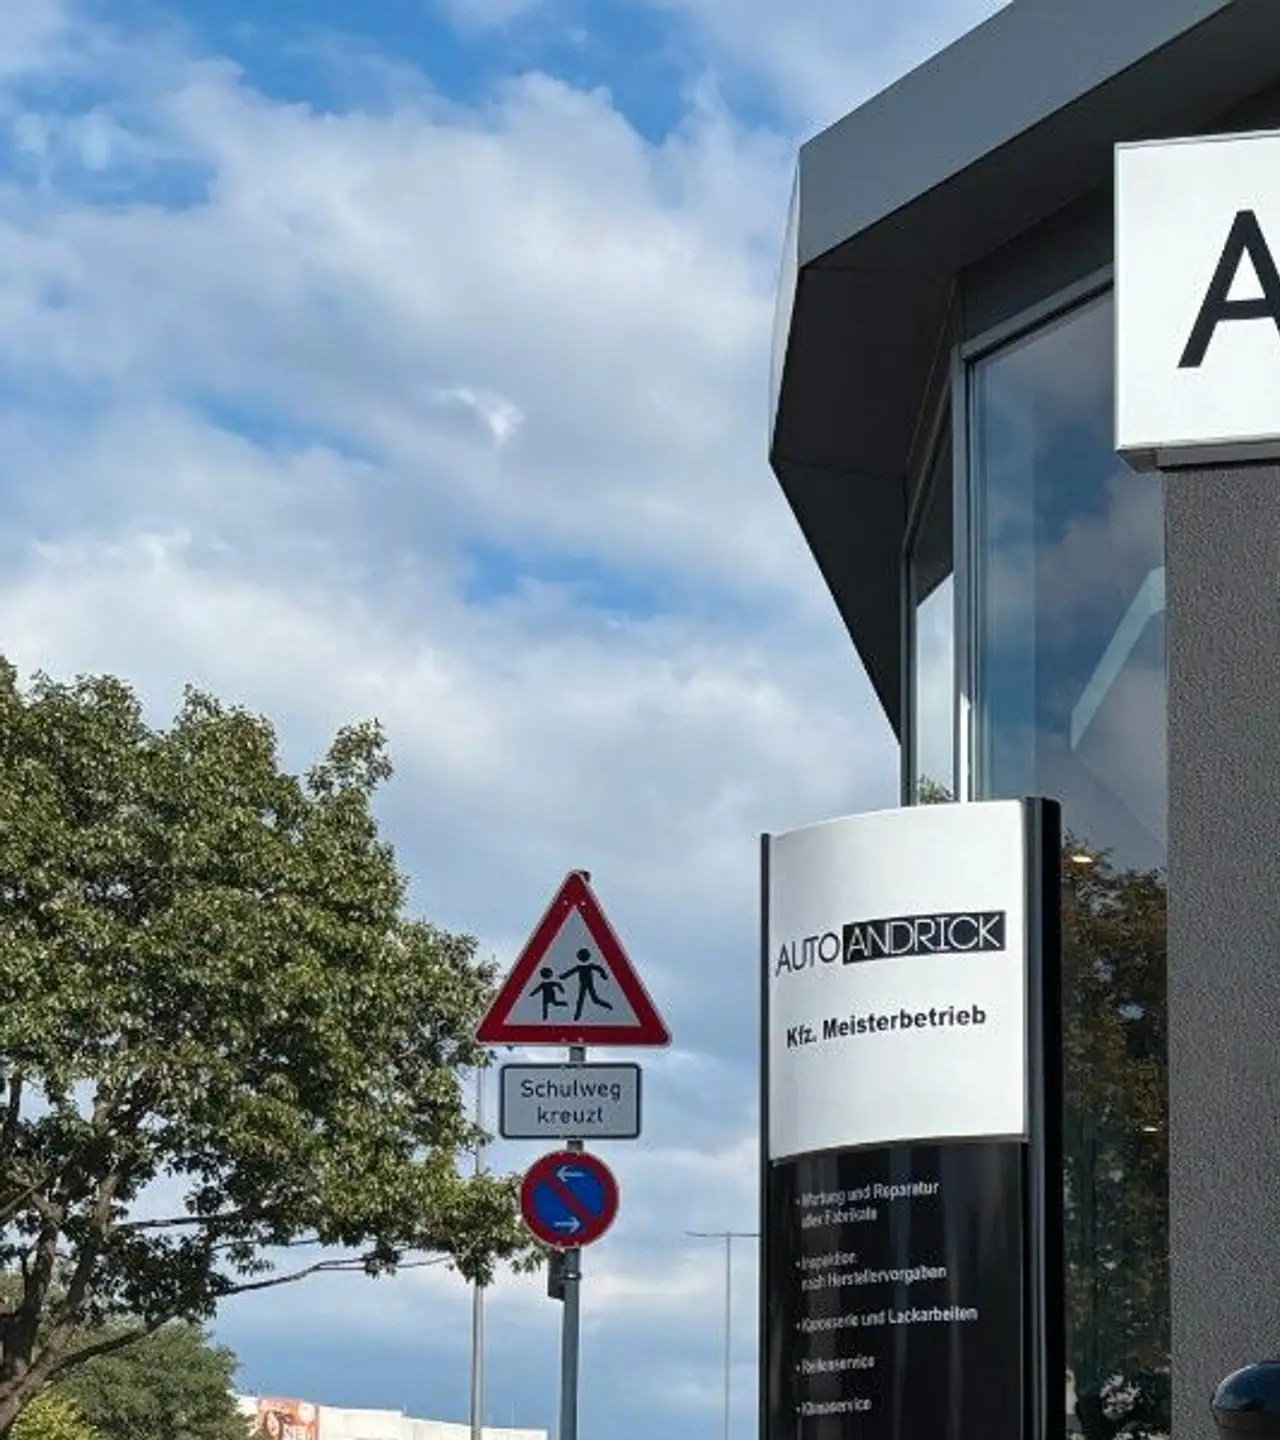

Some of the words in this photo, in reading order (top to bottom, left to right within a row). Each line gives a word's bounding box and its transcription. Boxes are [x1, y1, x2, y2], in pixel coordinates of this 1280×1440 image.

[775, 931, 841, 977] AUTO
[847, 914, 1001, 961] ANDRICK
[786, 1024, 817, 1049] Kfz.
[822, 1004, 987, 1040] Meisterbetrieb
[520, 1079, 622, 1102] Schulweg
[537, 1106, 605, 1125] kreuzt
[847, 1186, 870, 1202] und
[872, 1181, 940, 1201] Reparatur
[826, 1264, 947, 1288] Herstellervorgaben
[861, 1309, 886, 1327] und
[887, 1305, 979, 1325] Lackarbeiten
[801, 1353, 876, 1375] Reifenservice
